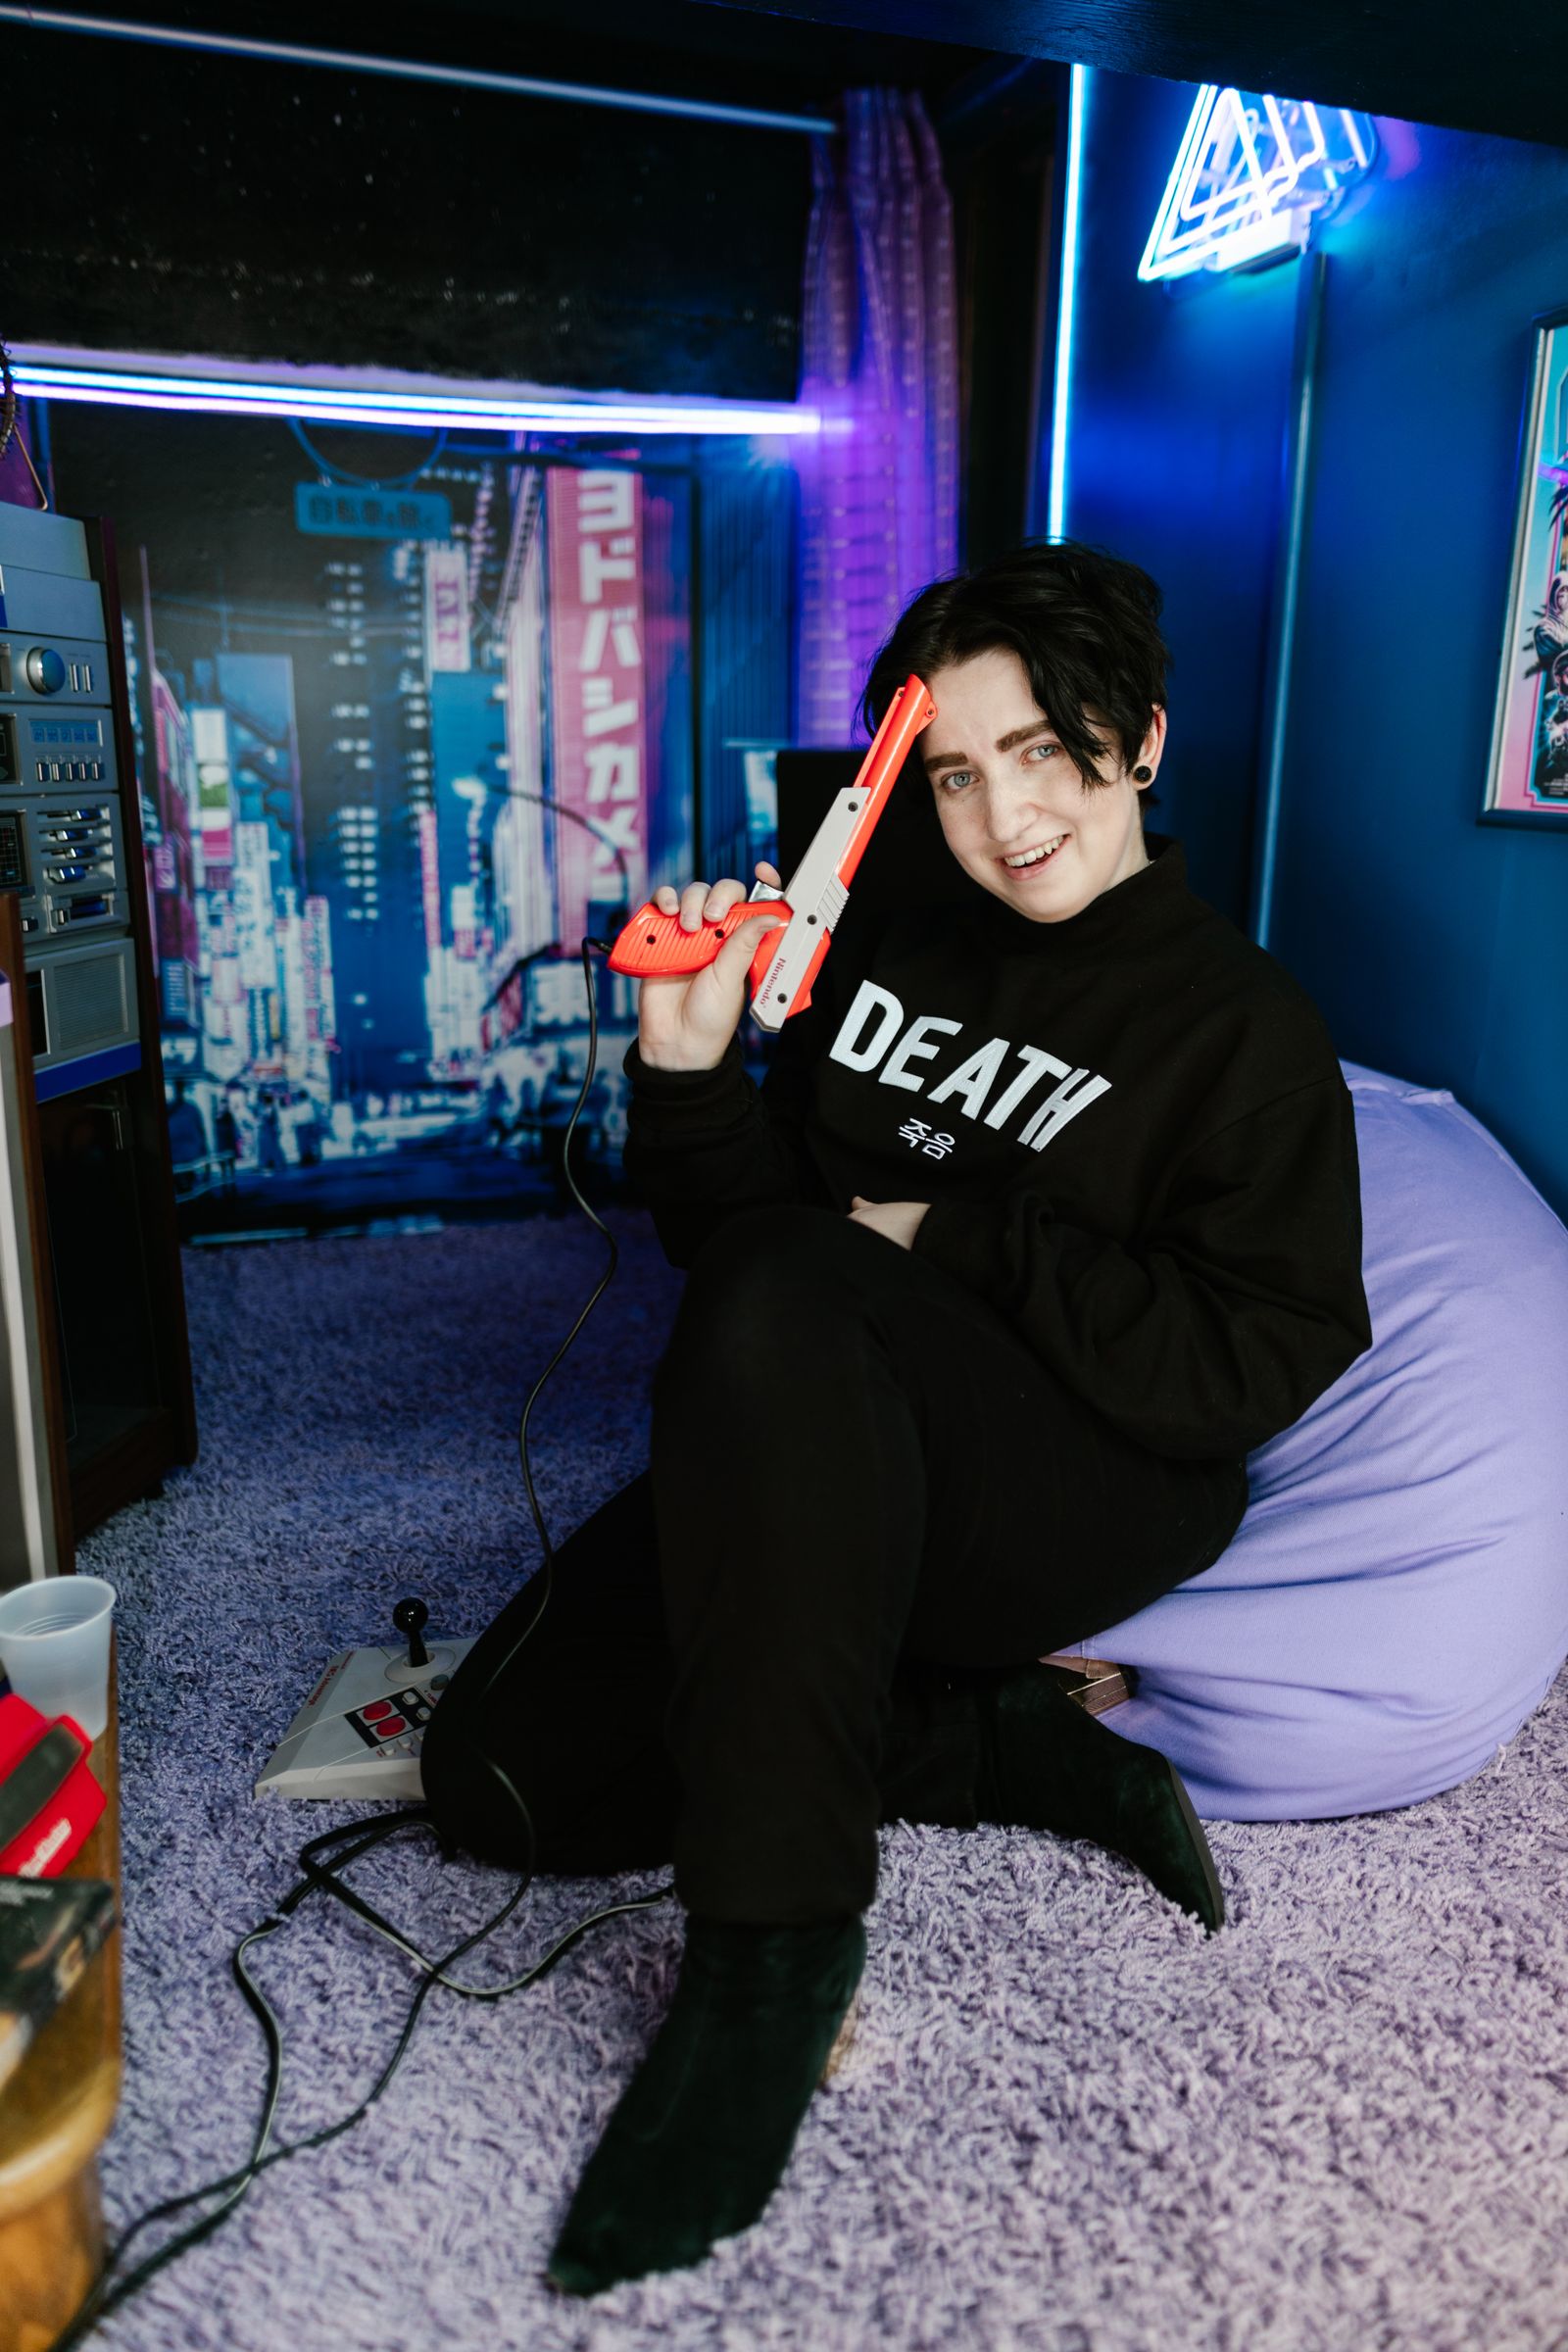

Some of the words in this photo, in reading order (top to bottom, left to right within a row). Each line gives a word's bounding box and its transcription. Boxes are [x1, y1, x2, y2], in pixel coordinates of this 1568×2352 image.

[760, 957, 786, 1004] Nintendo
[828, 979, 1112, 1152] DEATH
[898, 1117, 956, 1160] 죽음
